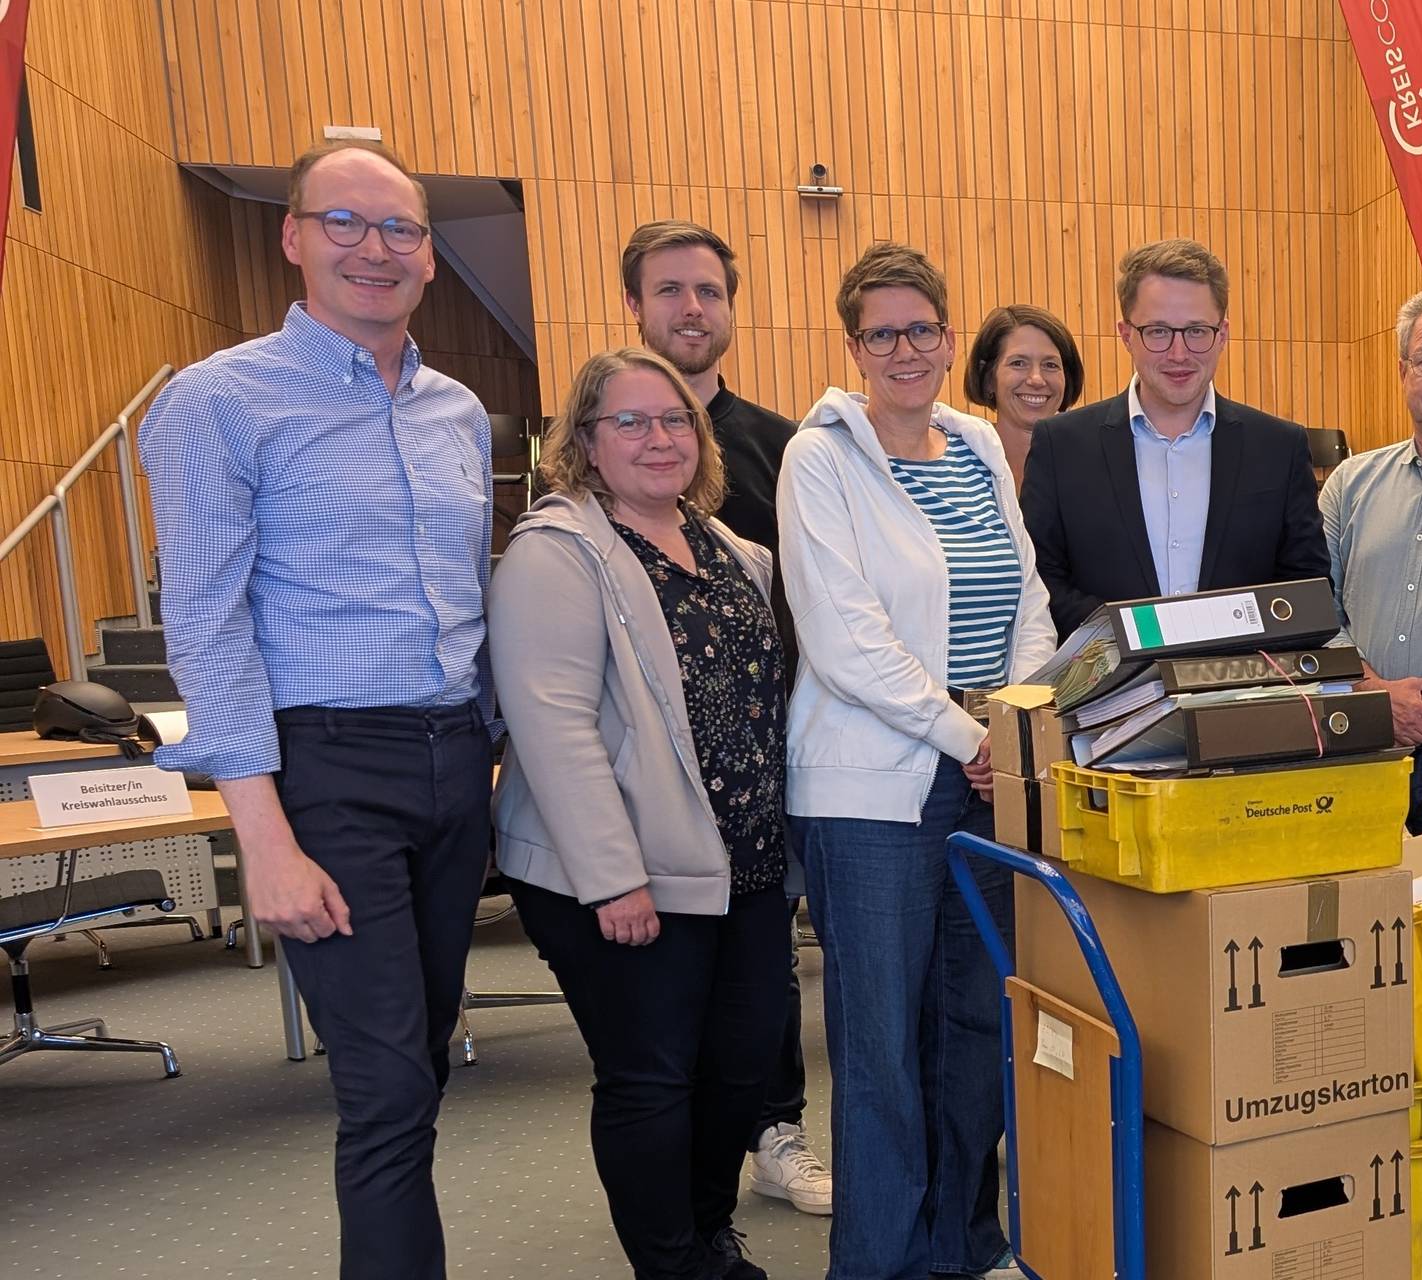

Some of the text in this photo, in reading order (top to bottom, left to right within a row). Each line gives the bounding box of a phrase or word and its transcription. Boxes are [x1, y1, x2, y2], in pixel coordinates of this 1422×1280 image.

[80, 780, 143, 794] Beisitzer/in
[61, 794, 168, 811] Kreiswahlausschuss
[1246, 803, 1312, 818] Deutsche Post
[1225, 1071, 1409, 1123] Umzugskarton
